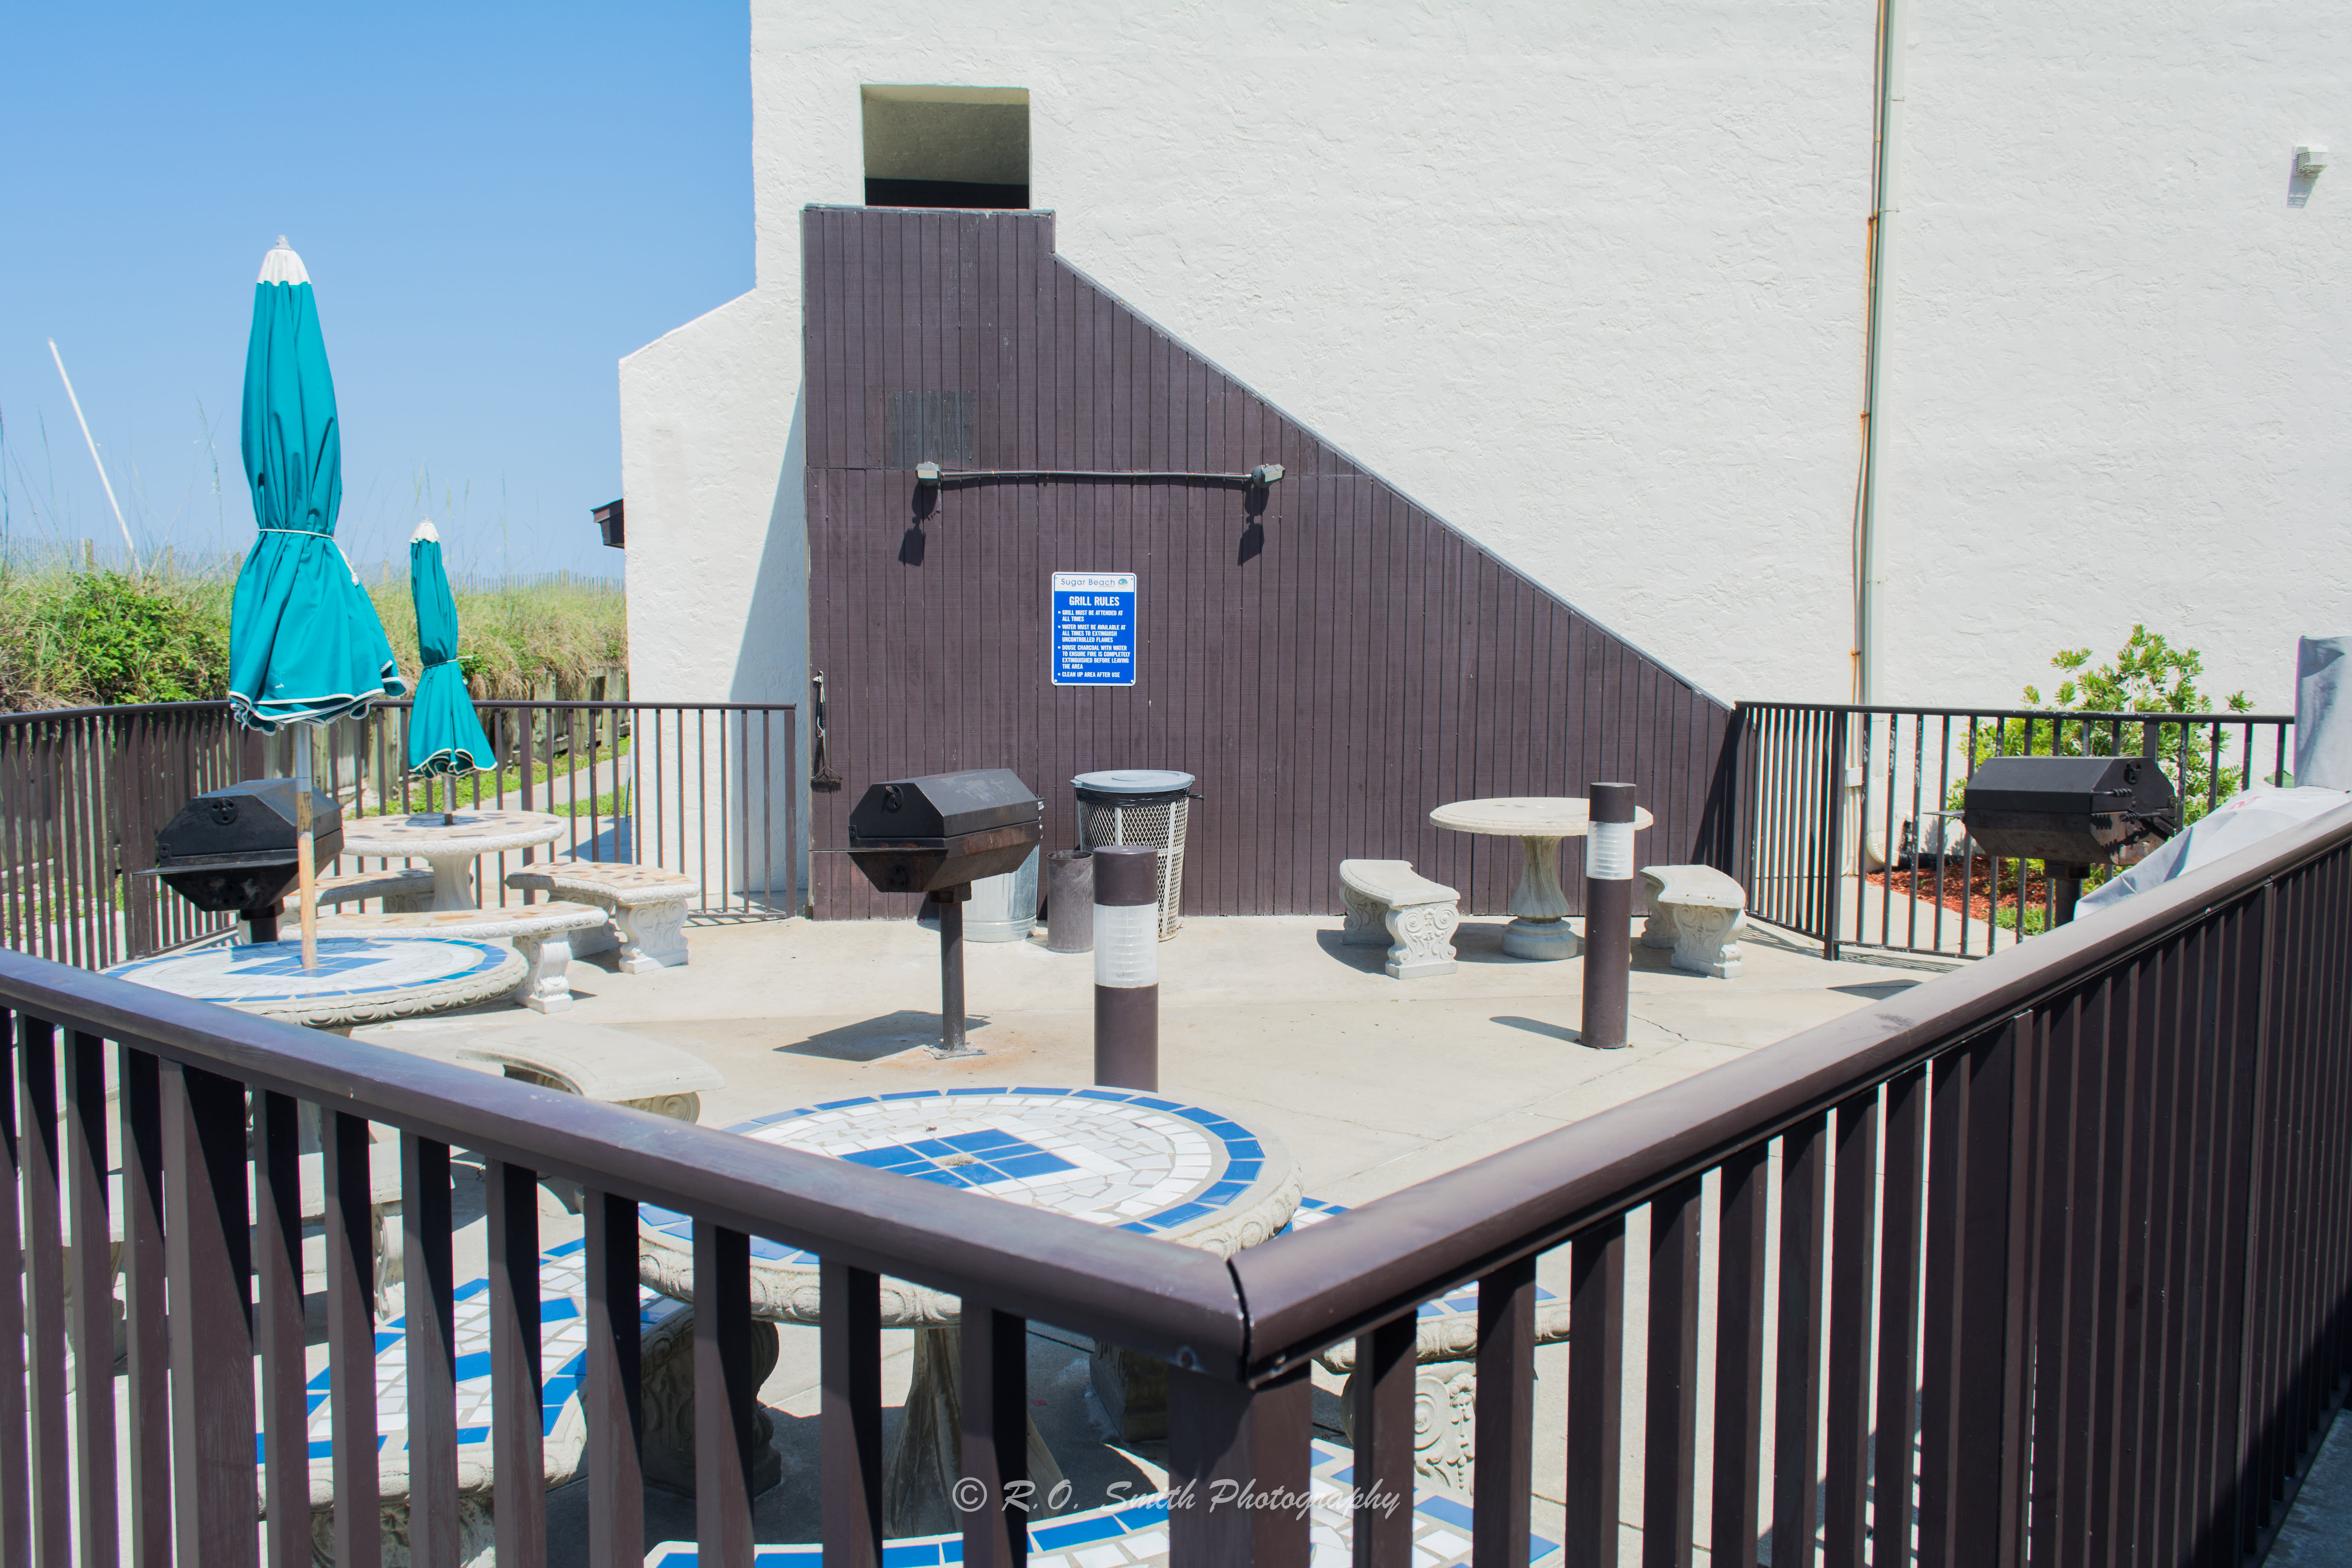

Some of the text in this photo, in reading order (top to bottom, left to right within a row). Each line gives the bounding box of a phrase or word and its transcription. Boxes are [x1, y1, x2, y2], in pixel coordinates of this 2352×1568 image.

[1061, 578, 1085, 586] Sugar
[1069, 596, 1120, 606] GRILL RULES
